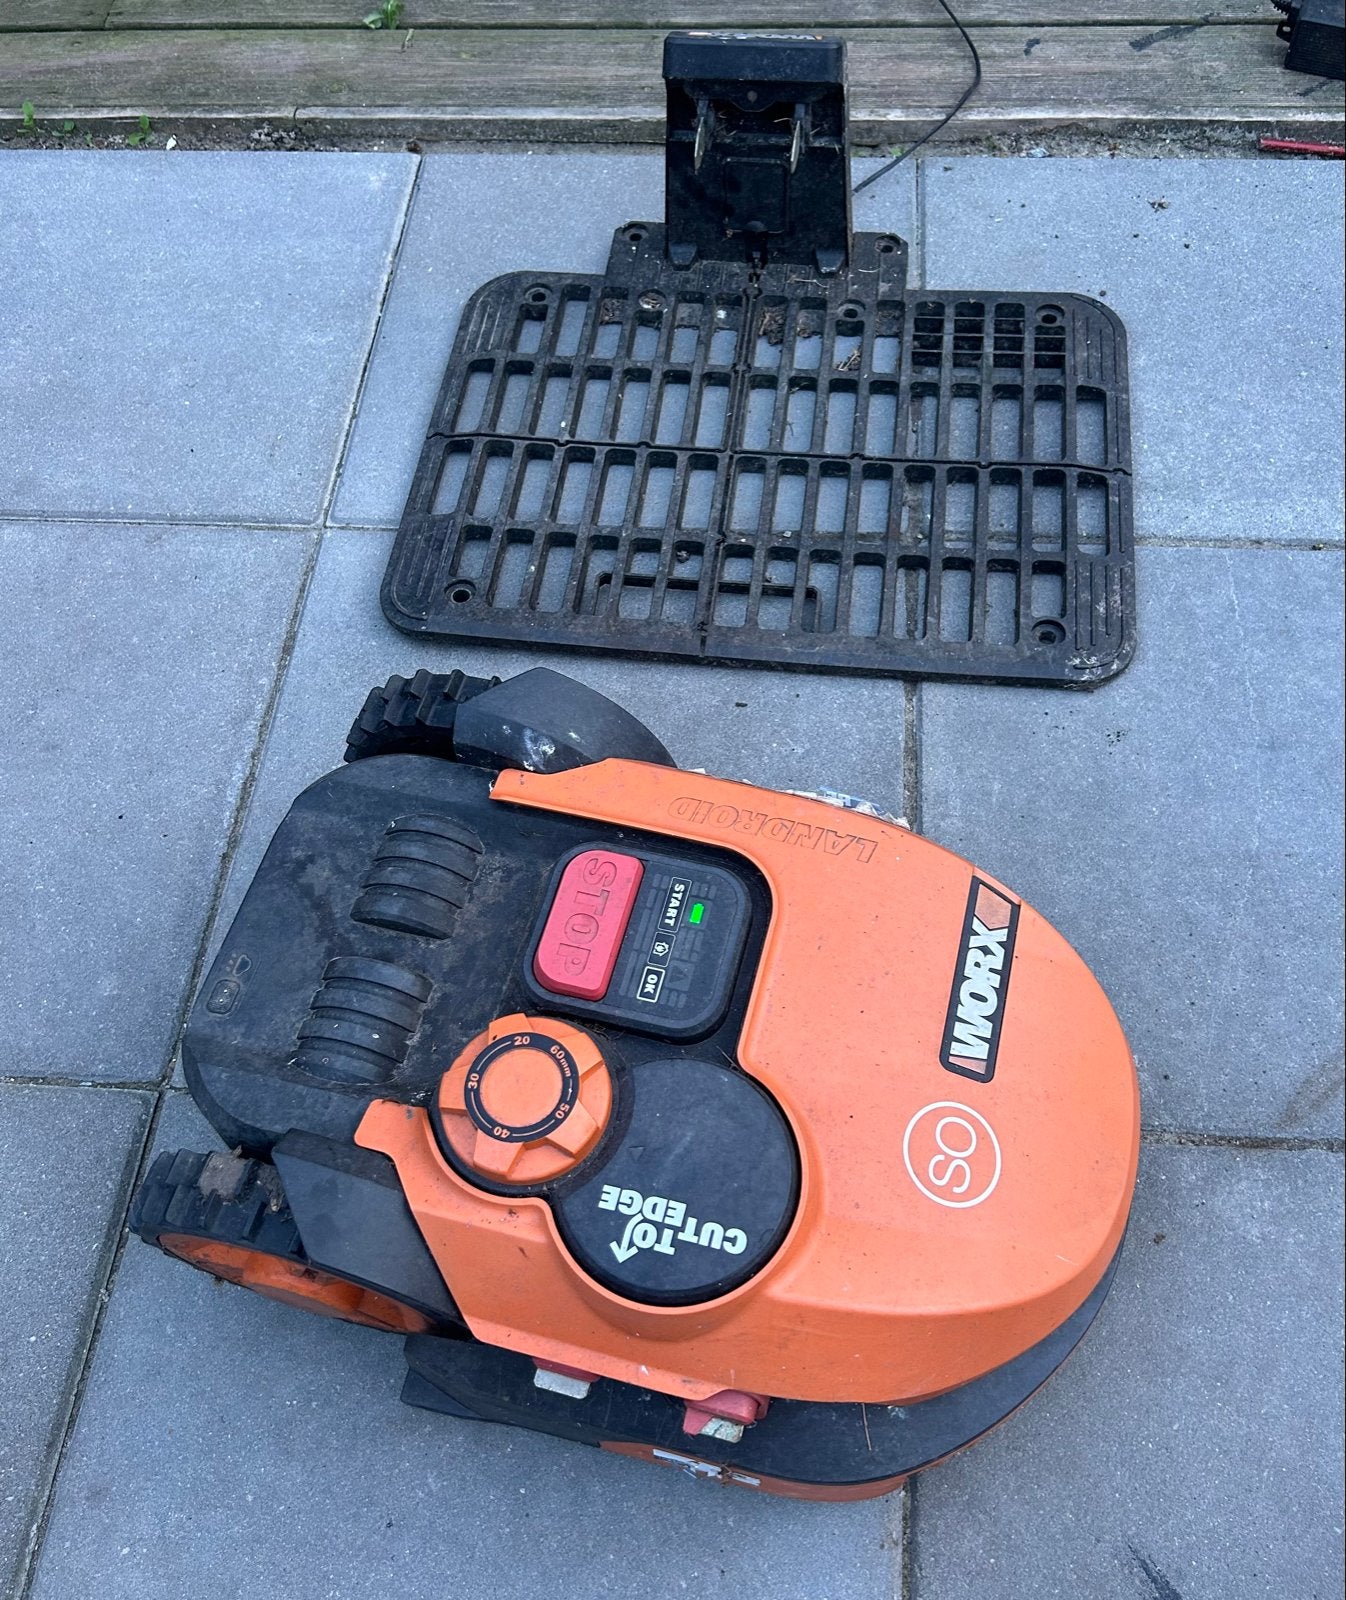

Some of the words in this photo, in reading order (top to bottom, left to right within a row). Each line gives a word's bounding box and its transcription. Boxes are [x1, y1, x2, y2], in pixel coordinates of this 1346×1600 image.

[669, 796, 879, 864] LANDROID
[556, 856, 618, 978] STOP
[662, 883, 686, 927] START
[644, 975, 659, 994] OK
[949, 916, 1009, 1060] WORX
[514, 1035, 531, 1046] 20
[550, 1044, 572, 1078] 60mm
[468, 1073, 479, 1090] 30
[556, 1102, 571, 1120] 50
[493, 1126, 511, 1139] 40
[597, 1184, 687, 1227] EDGE
[633, 1223, 676, 1256] TO
[678, 1215, 748, 1255] CUT
